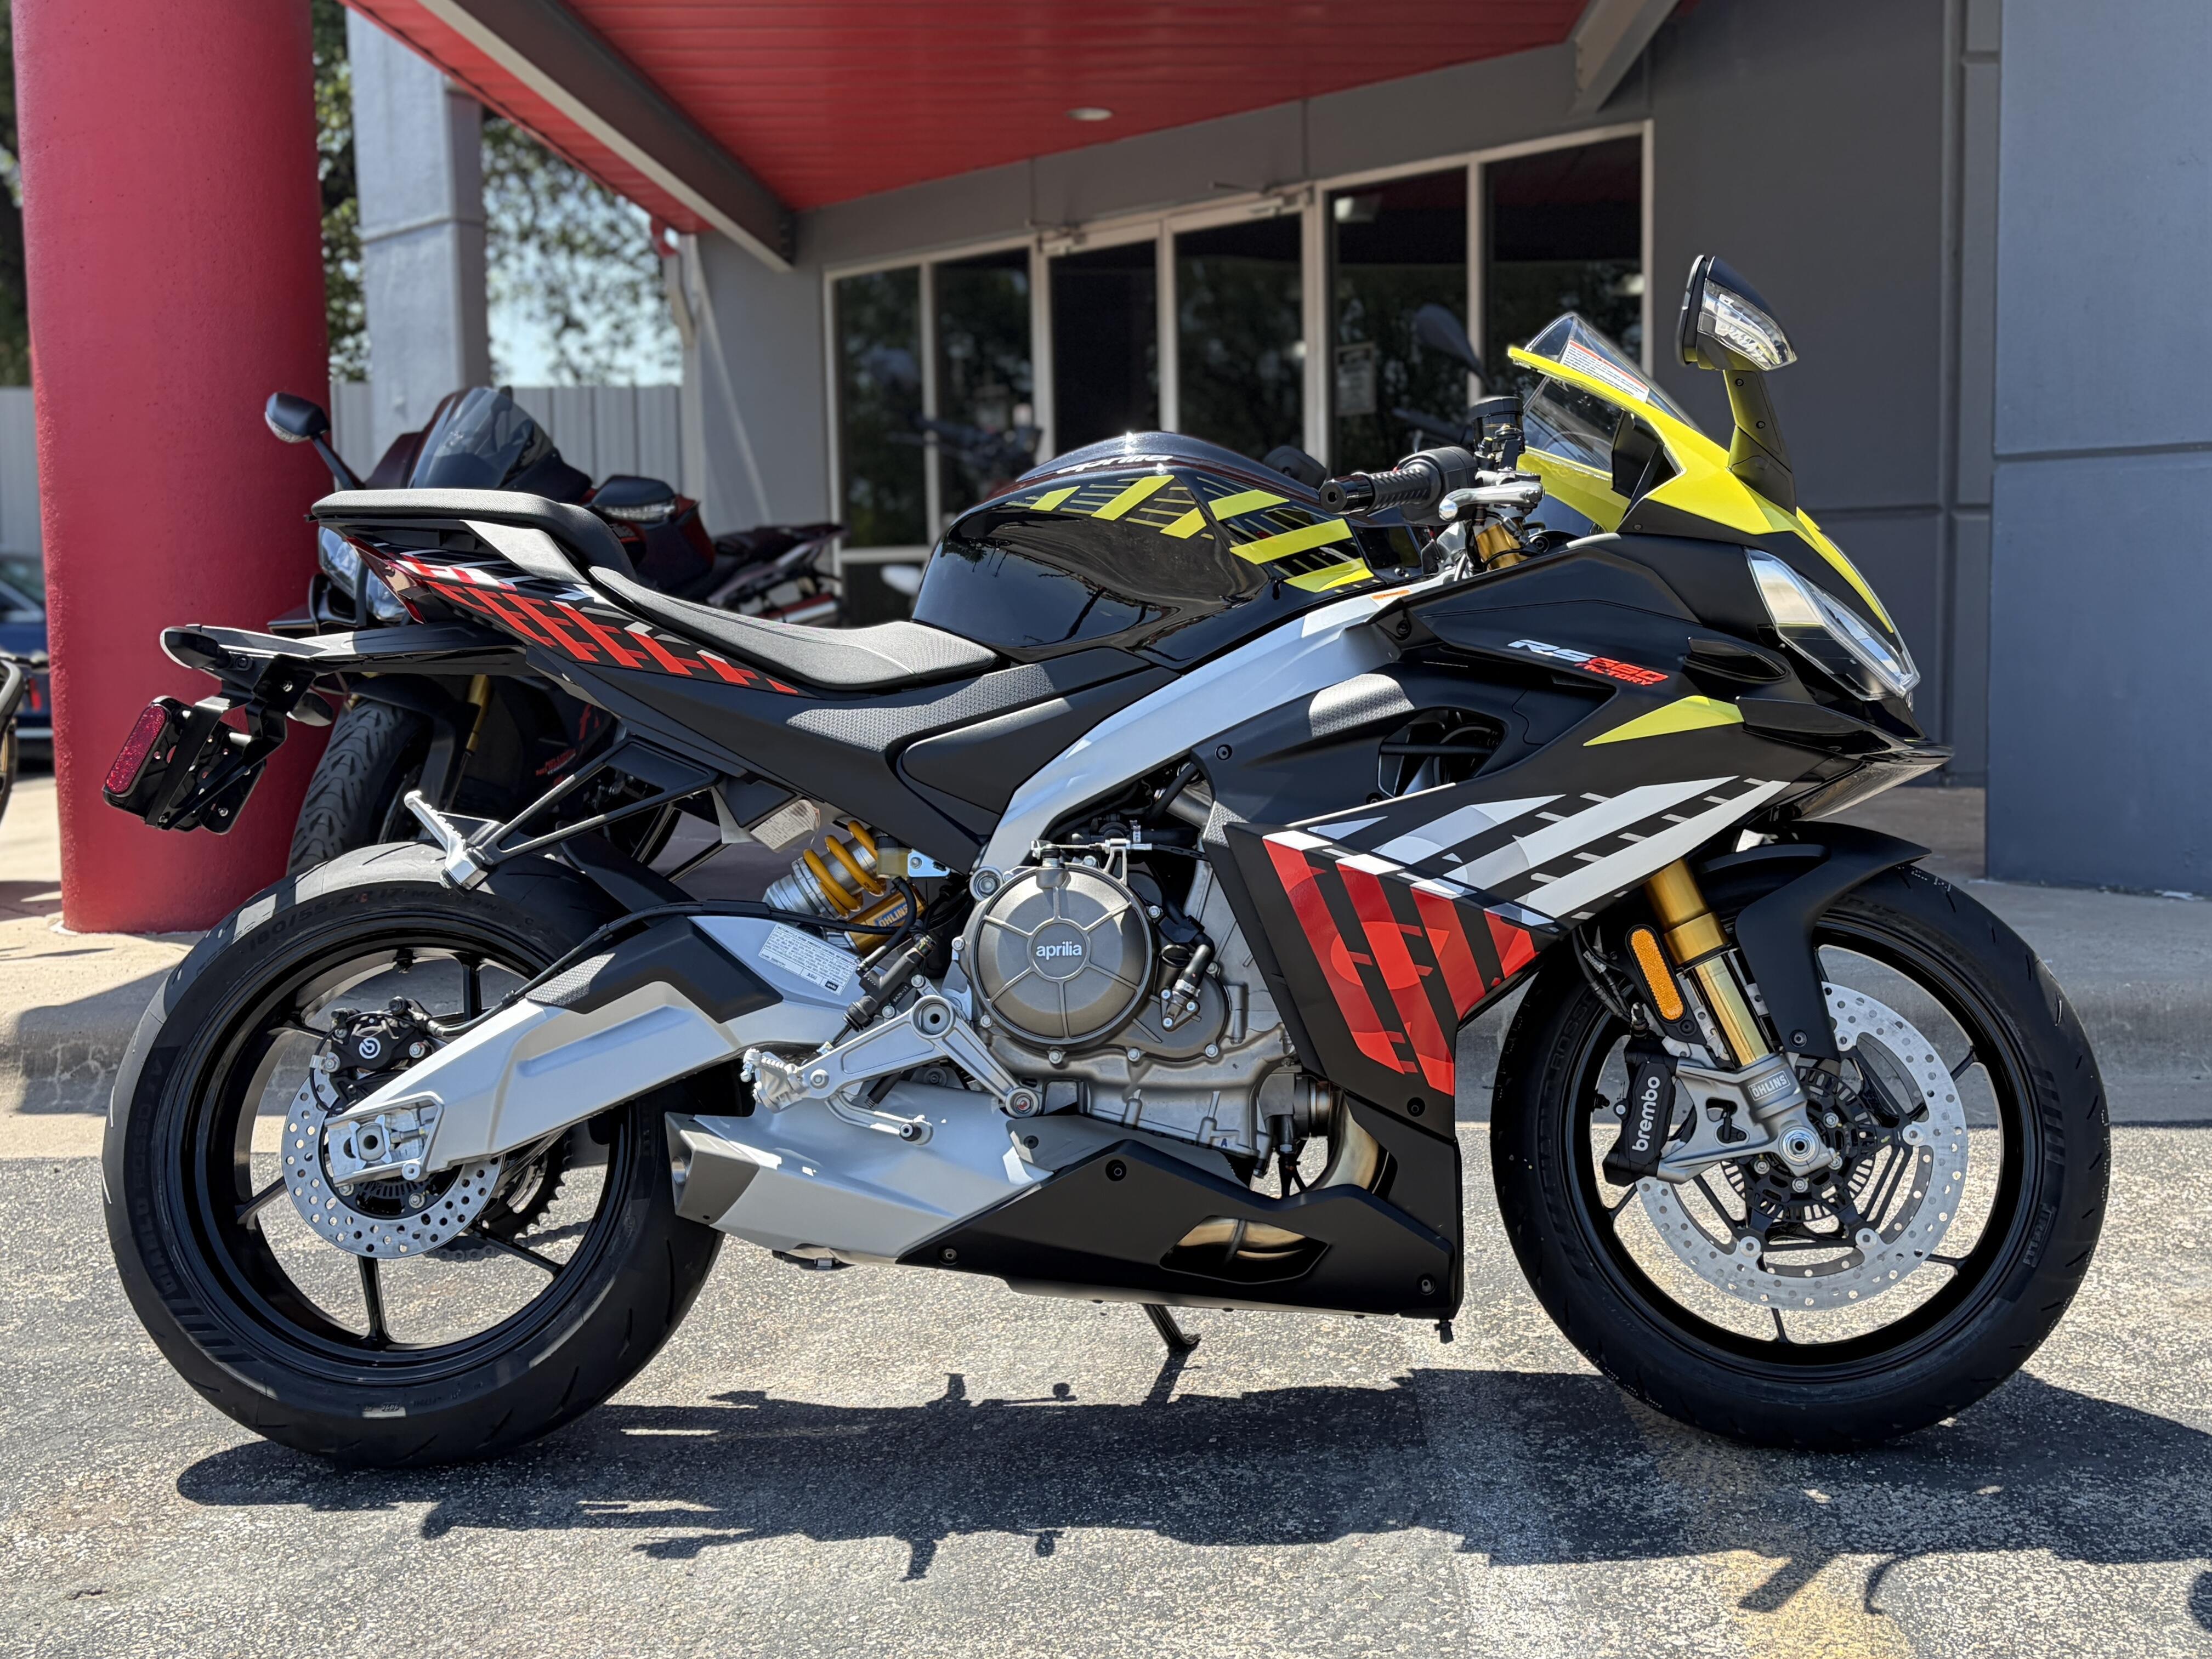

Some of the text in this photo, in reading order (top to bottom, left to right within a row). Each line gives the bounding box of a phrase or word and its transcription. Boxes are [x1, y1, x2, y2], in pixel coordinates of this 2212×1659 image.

[1056, 454, 1174, 474] aprilia
[1036, 941, 1082, 960] aprilia
[1751, 1072, 1789, 1099] ÖHLINS
[1632, 1076, 1660, 1152] brembo
